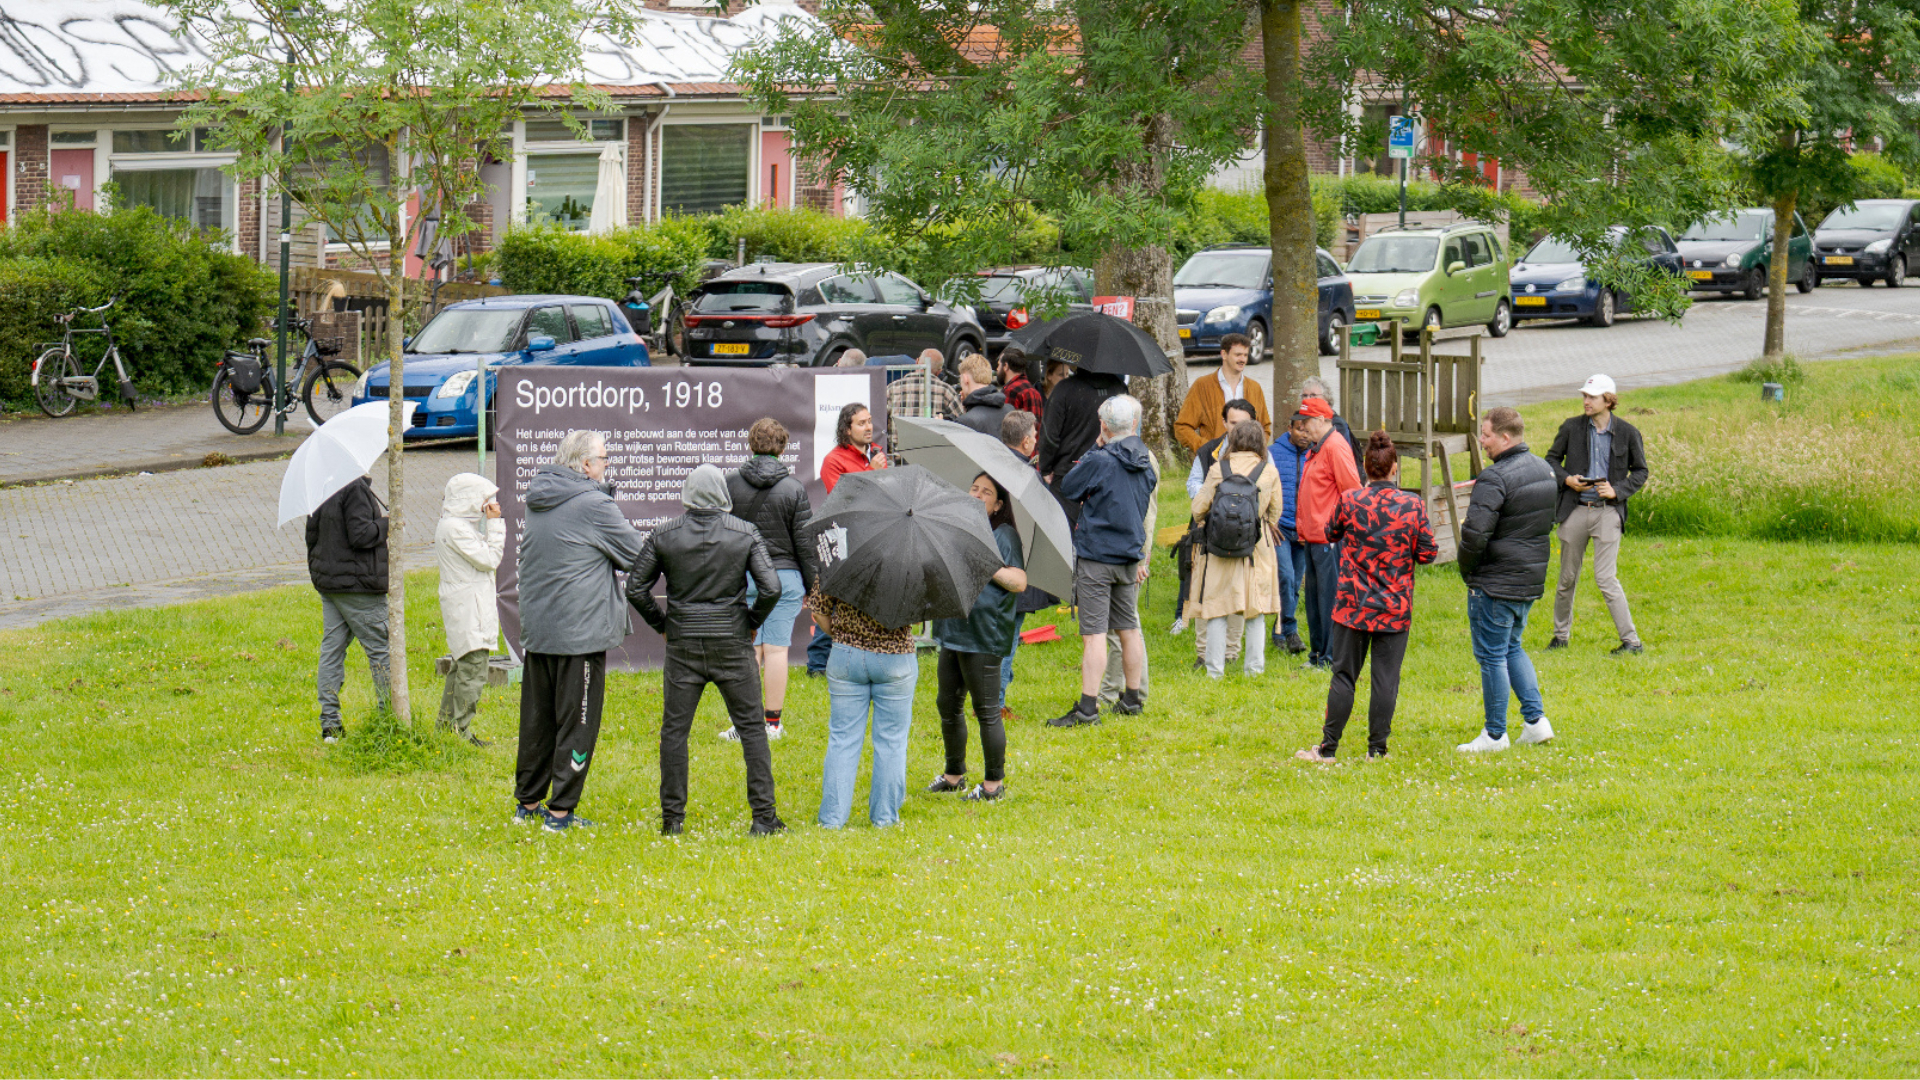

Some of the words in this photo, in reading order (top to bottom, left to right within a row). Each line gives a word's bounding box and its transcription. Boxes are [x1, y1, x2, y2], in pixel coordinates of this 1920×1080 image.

[516, 379, 650, 414] Sportdorp,
[661, 381, 723, 408] 1918
[516, 429, 532, 439] Het
[535, 429, 565, 439] unieke
[613, 428, 622, 439] is
[624, 428, 664, 441] gebouwd
[666, 430, 683, 438] aan
[685, 428, 697, 438] de
[700, 429, 718, 438] voet
[720, 430, 736, 438] van
[516, 443, 528, 452] en
[530, 441, 539, 452] is
[540, 441, 558, 452] één
[604, 442, 624, 452] dste
[626, 441, 654, 455] wijken
[656, 443, 673, 451] van
[674, 441, 722, 451] Rotterdam.
[724, 441, 742, 451] Een
[516, 456, 534, 465] een
[629, 453, 655, 463] trotse
[657, 453, 700, 463] bewoners
[702, 453, 723, 463] klaar
[725, 454, 749, 463] staan
[620, 465, 655, 476] officieel
